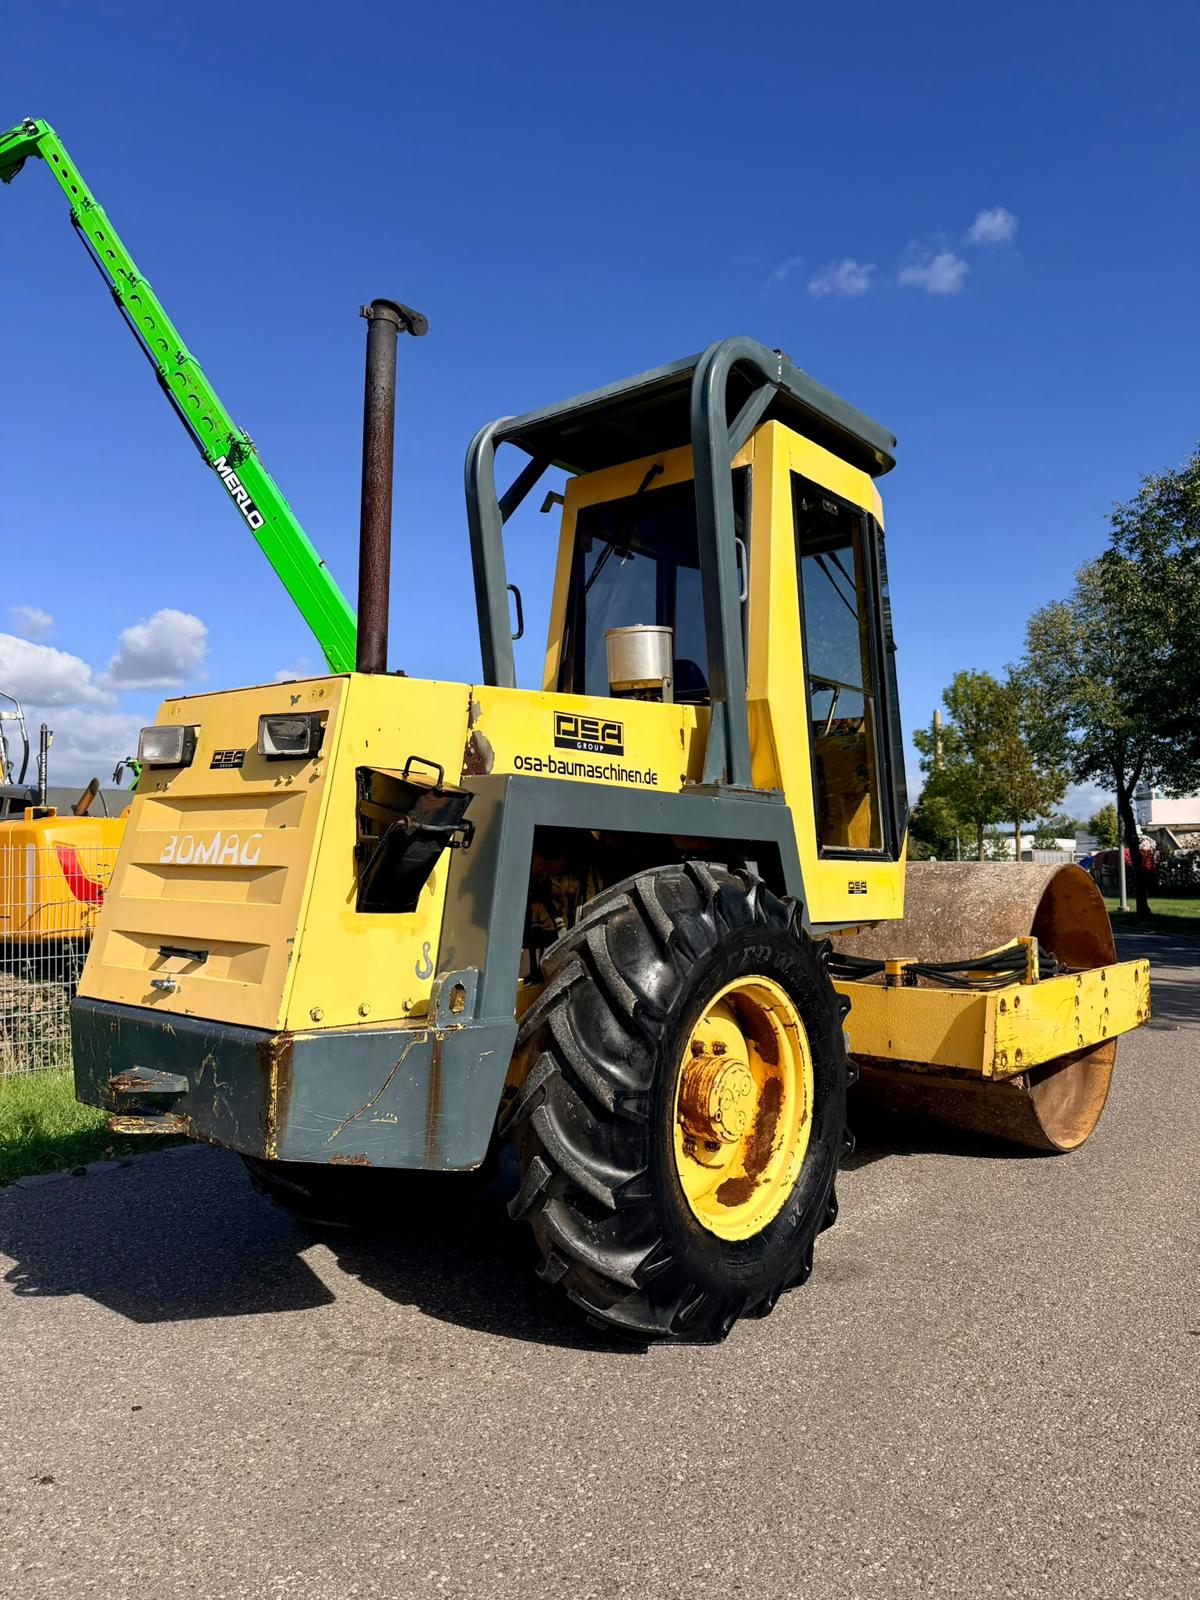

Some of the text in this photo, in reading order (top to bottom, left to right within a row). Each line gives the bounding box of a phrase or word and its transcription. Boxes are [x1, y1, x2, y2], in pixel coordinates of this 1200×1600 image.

[213, 456, 264, 529] MERLO
[556, 714, 622, 744] OSA
[576, 741, 604, 752] GROUP
[514, 755, 658, 785] osa-baumaschinen.de
